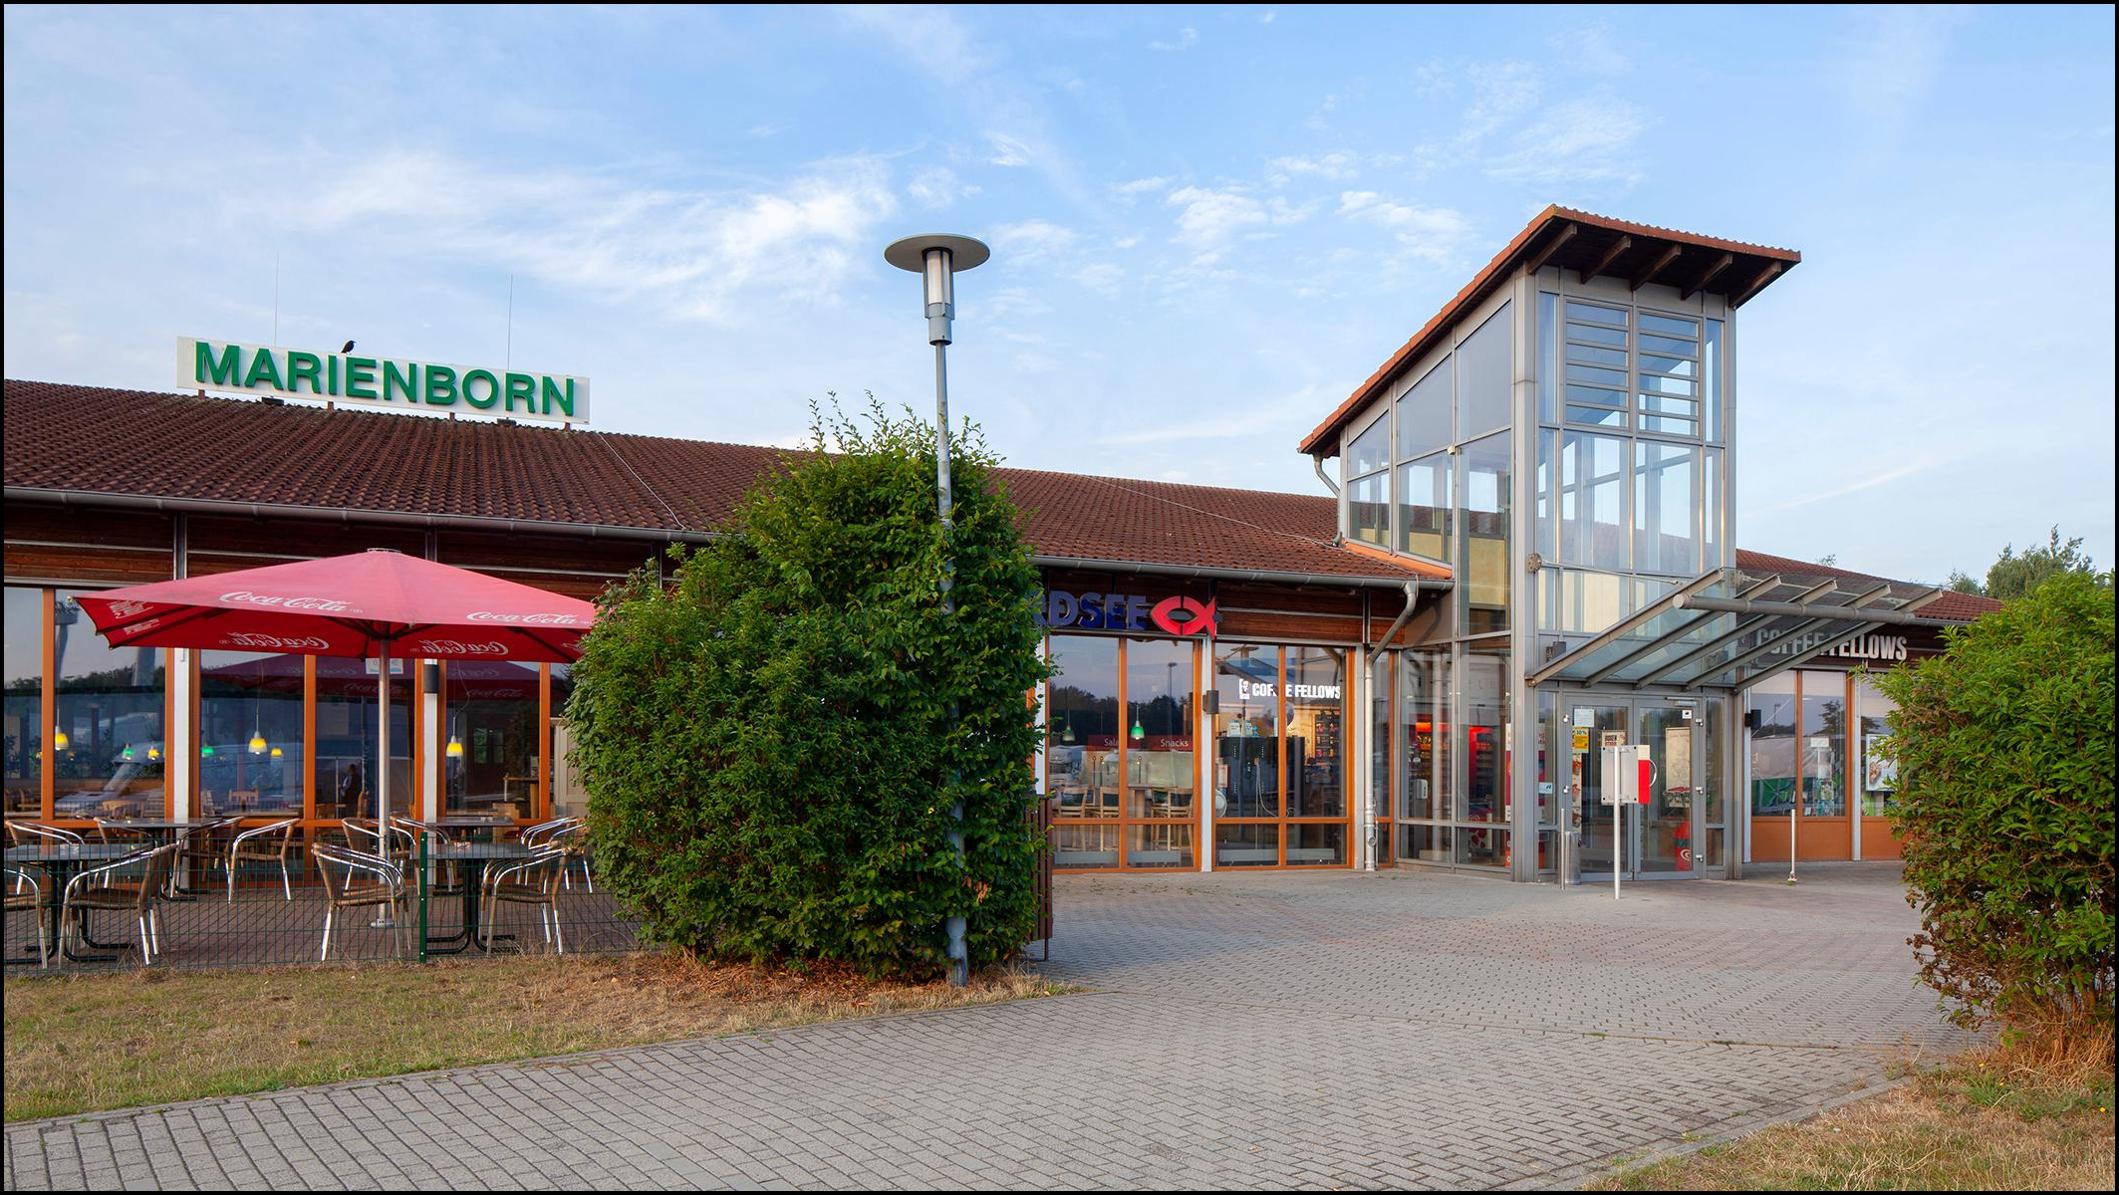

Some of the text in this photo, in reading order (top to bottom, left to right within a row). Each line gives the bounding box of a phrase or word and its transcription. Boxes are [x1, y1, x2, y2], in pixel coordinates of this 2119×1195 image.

[195, 340, 575, 417] MARIENBORN
[219, 590, 352, 612] Coca-Cola
[466, 611, 578, 625] Coca-Cola
[1252, 682, 1341, 699] COFE FELLOWS
[1160, 738, 1189, 748] Snacks
